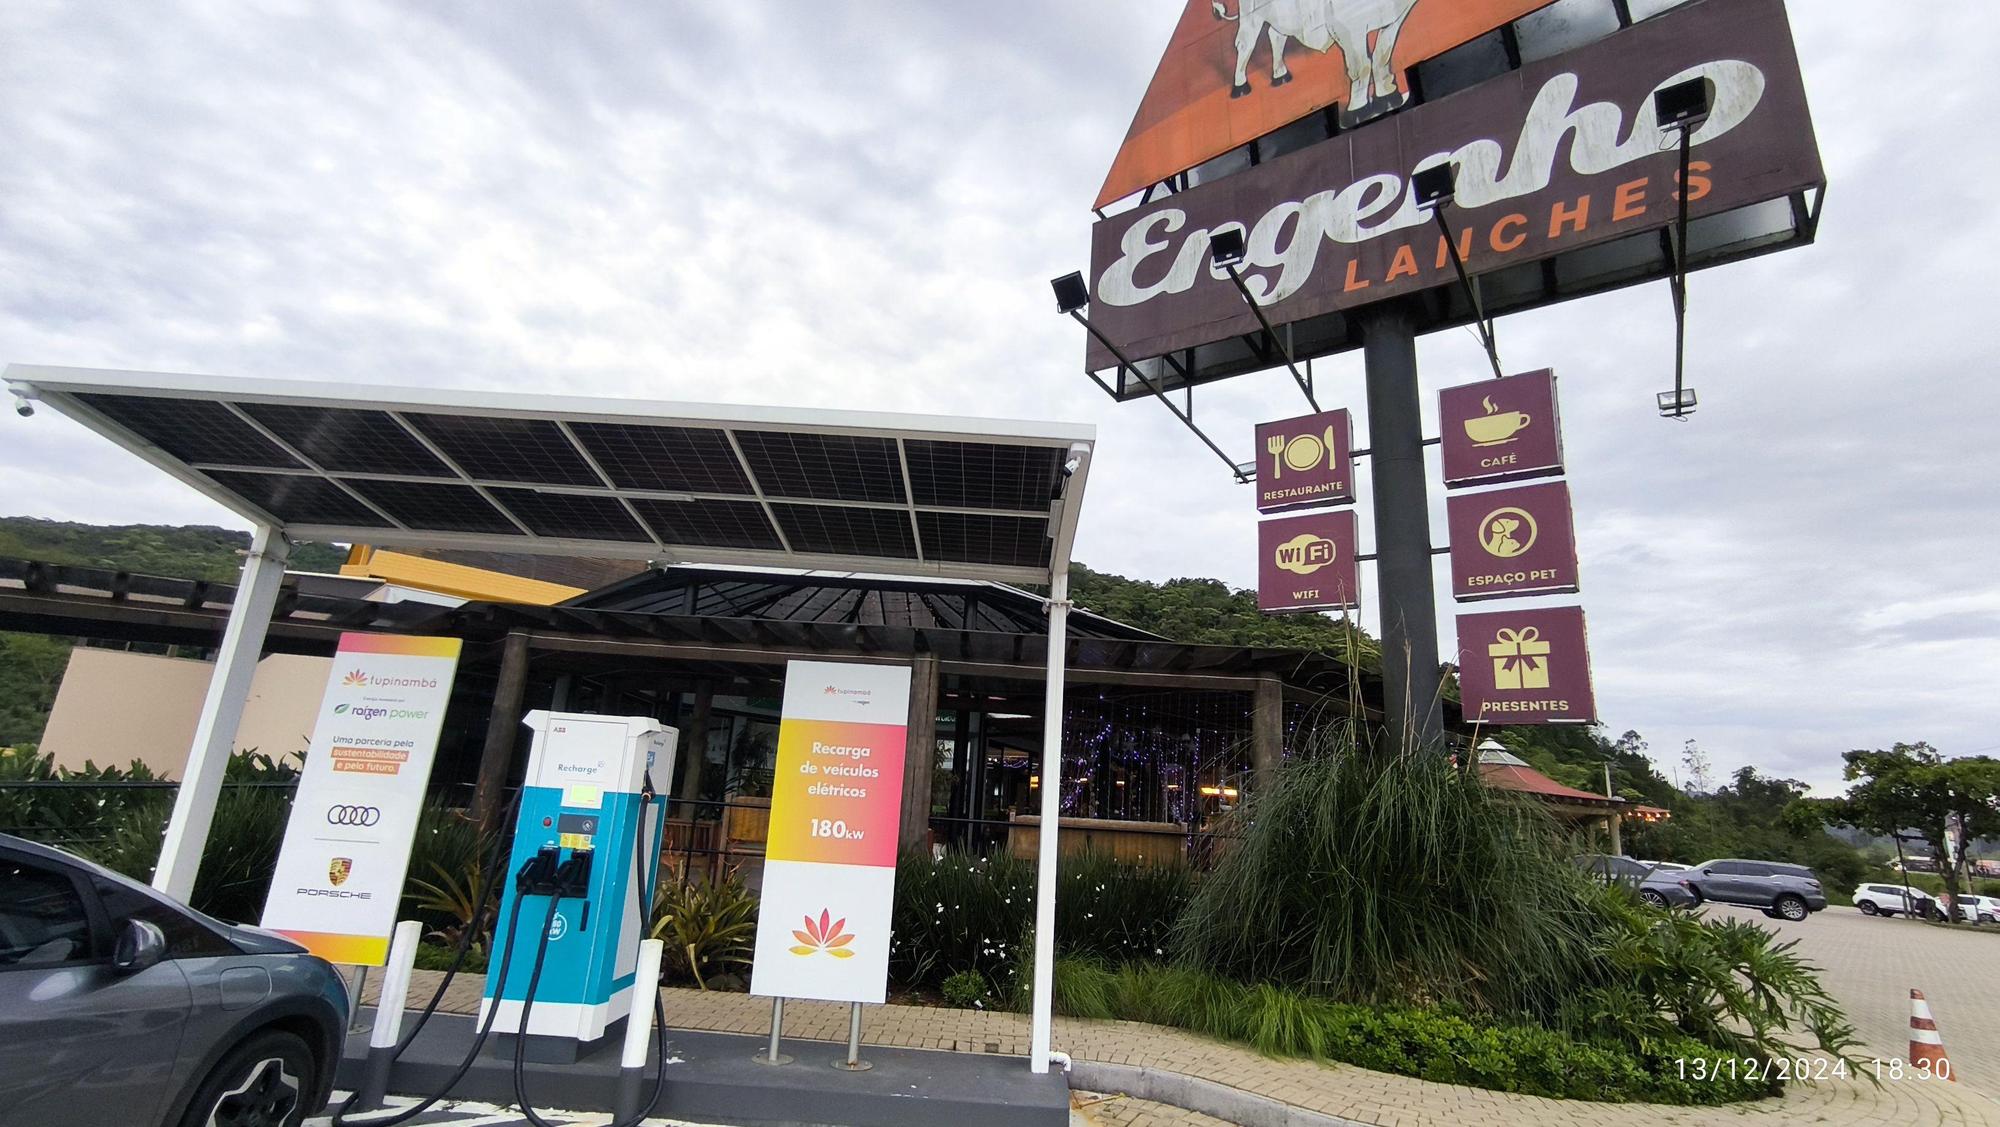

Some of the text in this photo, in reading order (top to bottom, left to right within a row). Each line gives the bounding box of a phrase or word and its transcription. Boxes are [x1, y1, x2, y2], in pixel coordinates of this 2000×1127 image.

[1098, 59, 1765, 306] Engenho
[1344, 160, 1712, 292] LANCHES
[1480, 452, 1517, 468] CAFÉ
[1264, 481, 1343, 500] RESTAURANTE
[1468, 569, 1557, 586] ESPAÇO PET
[1293, 589, 1320, 600] WIFI
[370, 675, 437, 688] tupinambá
[1482, 700, 1569, 713] PRESENTES
[389, 708, 428, 719] power
[333, 736, 414, 748] Uma parceria pela
[333, 748, 407, 760] sustentabilidade
[812, 742, 870, 760] Recarga
[344, 760, 364, 771] pelo
[558, 763, 597, 775] Recharge
[800, 761, 879, 778] de veículos
[808, 782, 866, 798] elétricos
[297, 888, 372, 900] PORSCHE
